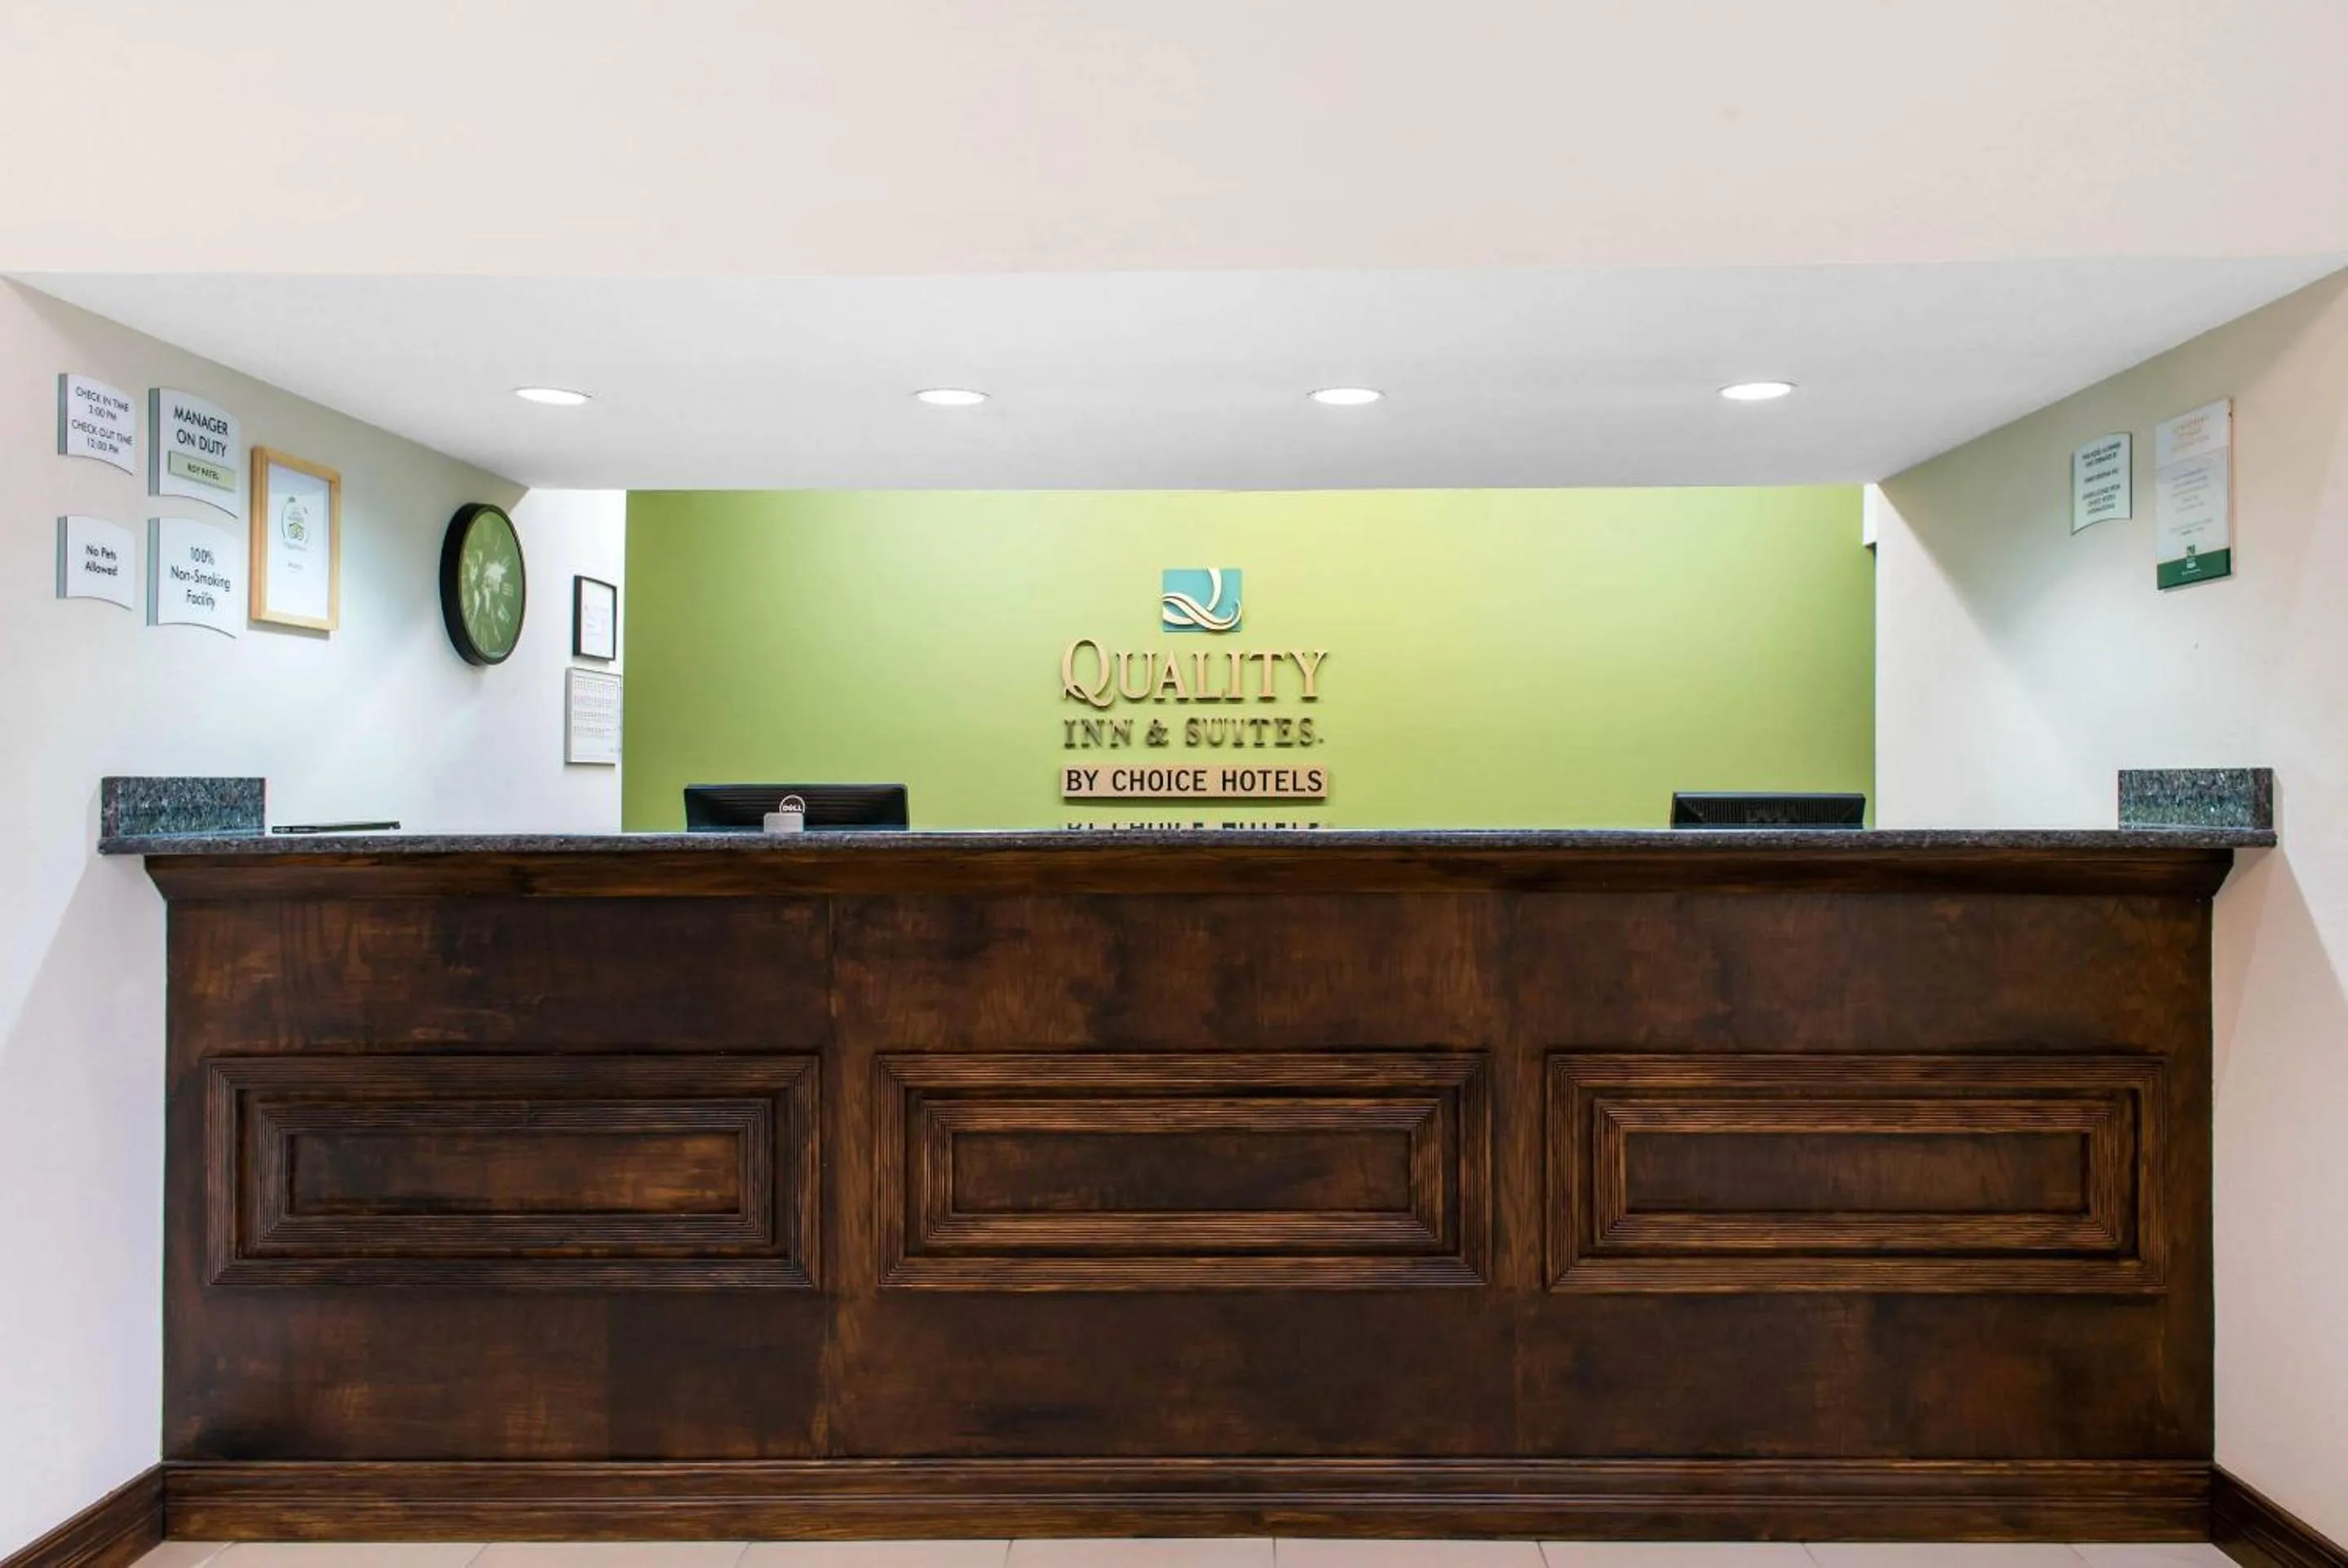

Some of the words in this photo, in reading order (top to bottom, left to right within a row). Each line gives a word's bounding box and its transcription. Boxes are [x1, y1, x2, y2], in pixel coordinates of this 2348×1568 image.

[174, 405, 228, 435] MANAGER
[176, 428, 196, 447] ON
[198, 435, 227, 457] DUTY
[86, 544, 99, 556] No
[101, 546, 117, 561] Pets
[190, 546, 214, 566] 100%
[85, 561, 118, 576] Allowed
[170, 565, 231, 592] Non-Smoking
[1062, 638, 1329, 709] QUALITY
[1063, 718, 1134, 749] INN
[1144, 718, 1170, 749] &
[1066, 769, 1099, 792] BY
[1112, 769, 1208, 792] CHOICE
[1222, 769, 1323, 792] HOTELS
[782, 804, 803, 812] DELL
